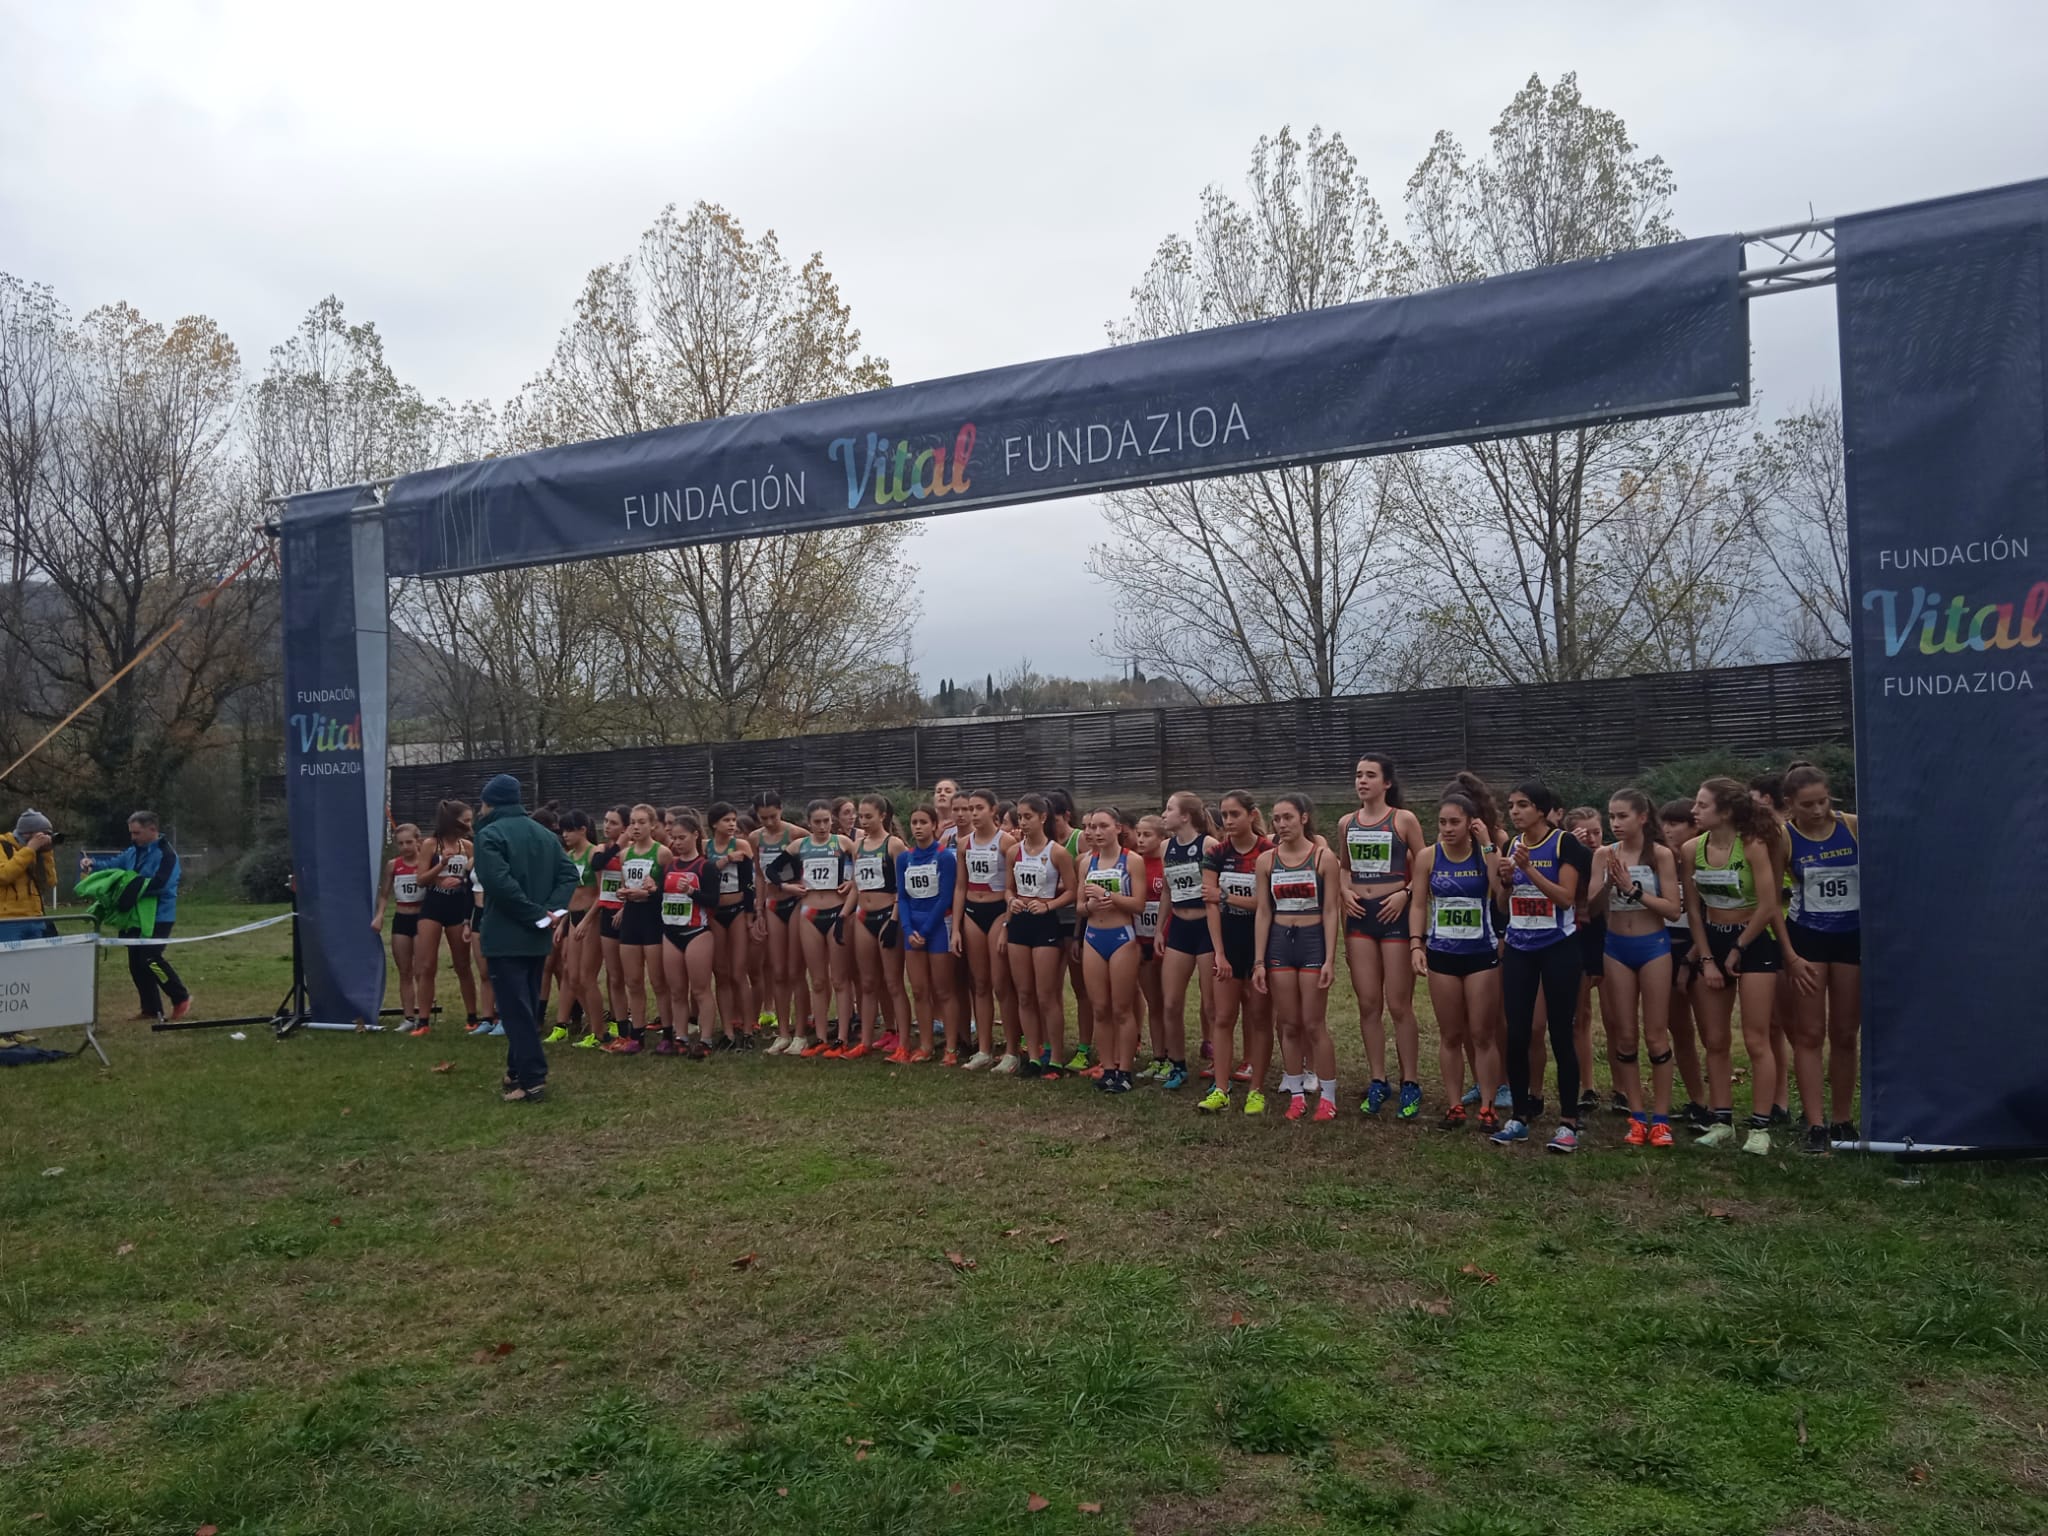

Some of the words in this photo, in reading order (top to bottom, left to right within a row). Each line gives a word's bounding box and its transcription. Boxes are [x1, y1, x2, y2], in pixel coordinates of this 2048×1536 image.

[624, 464, 806, 531] FUNDACIÓN
[828, 422, 977, 509] Vital
[1005, 402, 1250, 476] FUNDAZIOA
[1880, 534, 2029, 570] FUNDACIÓN
[1862, 581, 2048, 657] Vital
[1884, 670, 2034, 697] FUNDAZIOA
[290, 712, 361, 753] Vital
[1355, 844, 1379, 860] 754
[1820, 848, 1853, 860] IRANZU
[627, 868, 643, 880] 186
[812, 868, 829, 881] 172
[860, 868, 875, 881] 171
[971, 861, 989, 874] 145
[910, 875, 930, 889] 169
[1020, 873, 1037, 887] 141
[1174, 876, 1196, 890] 192
[402, 883, 417, 894] 167
[1817, 879, 1849, 898] 195
[667, 903, 684, 915] 760
[1140, 912, 1158, 926] 160
[1444, 910, 1472, 926] 764
